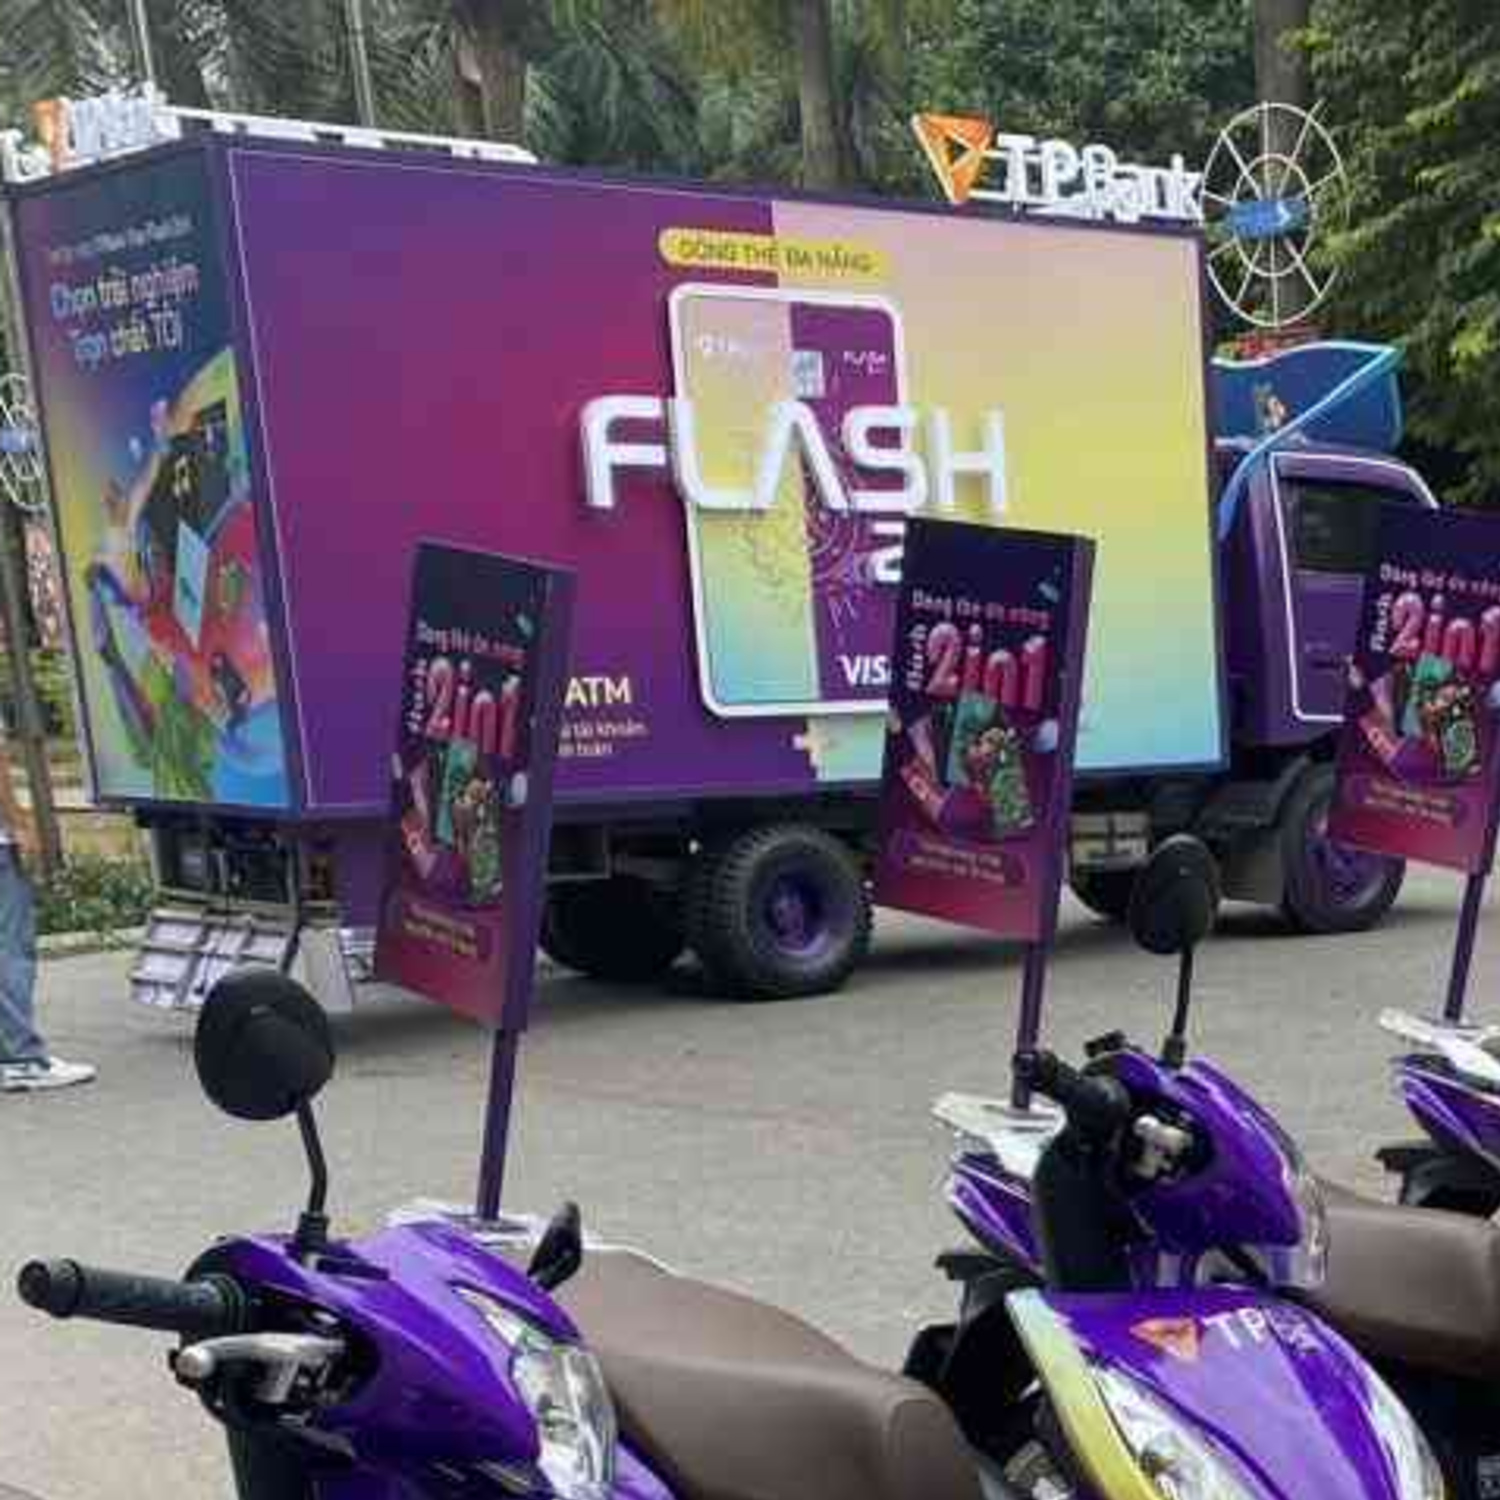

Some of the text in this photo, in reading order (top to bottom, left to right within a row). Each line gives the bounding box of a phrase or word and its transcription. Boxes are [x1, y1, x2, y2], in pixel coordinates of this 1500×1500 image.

[580, 396, 1007, 514] FLASH
[425, 656, 522, 756] 2in1
[564, 677, 632, 706] ATM
[841, 655, 891, 687] VIS
[926, 622, 1052, 711] 2in1
